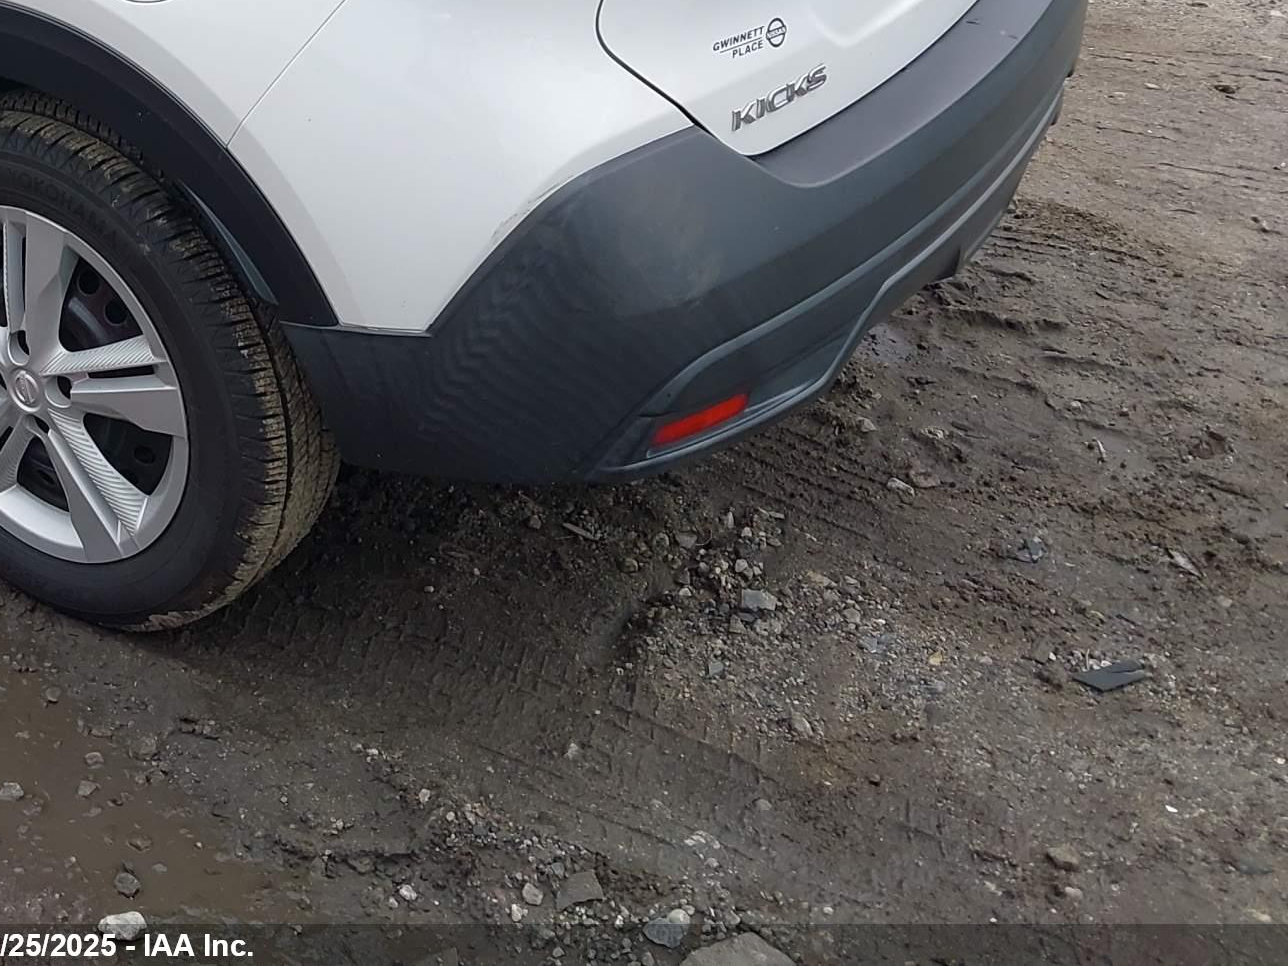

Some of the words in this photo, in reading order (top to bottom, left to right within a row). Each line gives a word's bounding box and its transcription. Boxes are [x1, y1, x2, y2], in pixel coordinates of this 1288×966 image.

[712, 25, 765, 52] GWINNETT
[732, 40, 764, 59] PLACE
[731, 63, 827, 131] KICKS
